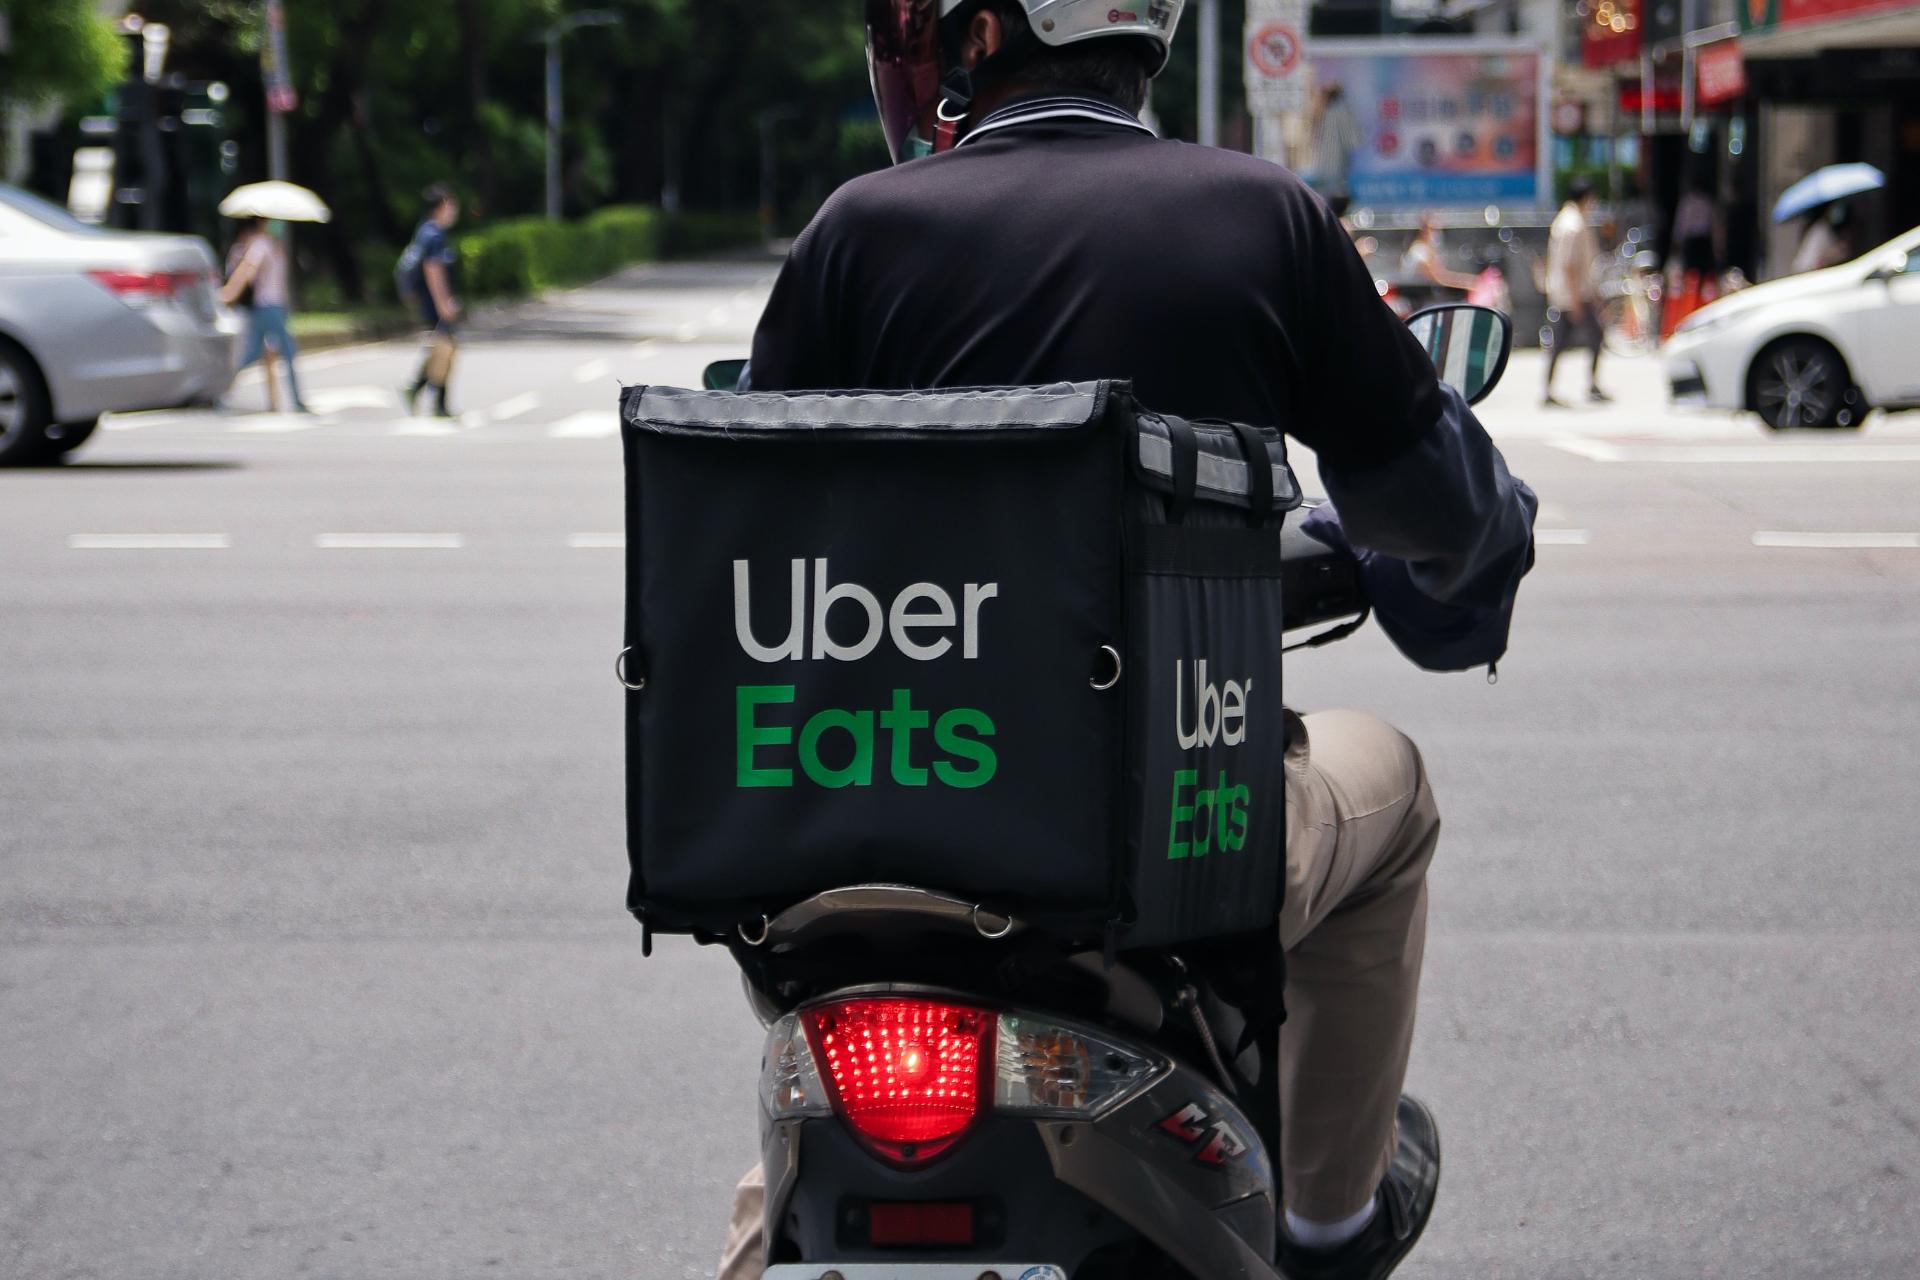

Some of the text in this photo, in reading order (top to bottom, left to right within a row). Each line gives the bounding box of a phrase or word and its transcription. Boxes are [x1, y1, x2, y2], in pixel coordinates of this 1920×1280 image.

[734, 558, 998, 662] Uber
[736, 684, 998, 788] Eats
[1176, 659, 1252, 750] Uber
[1167, 768, 1249, 859] Eats
